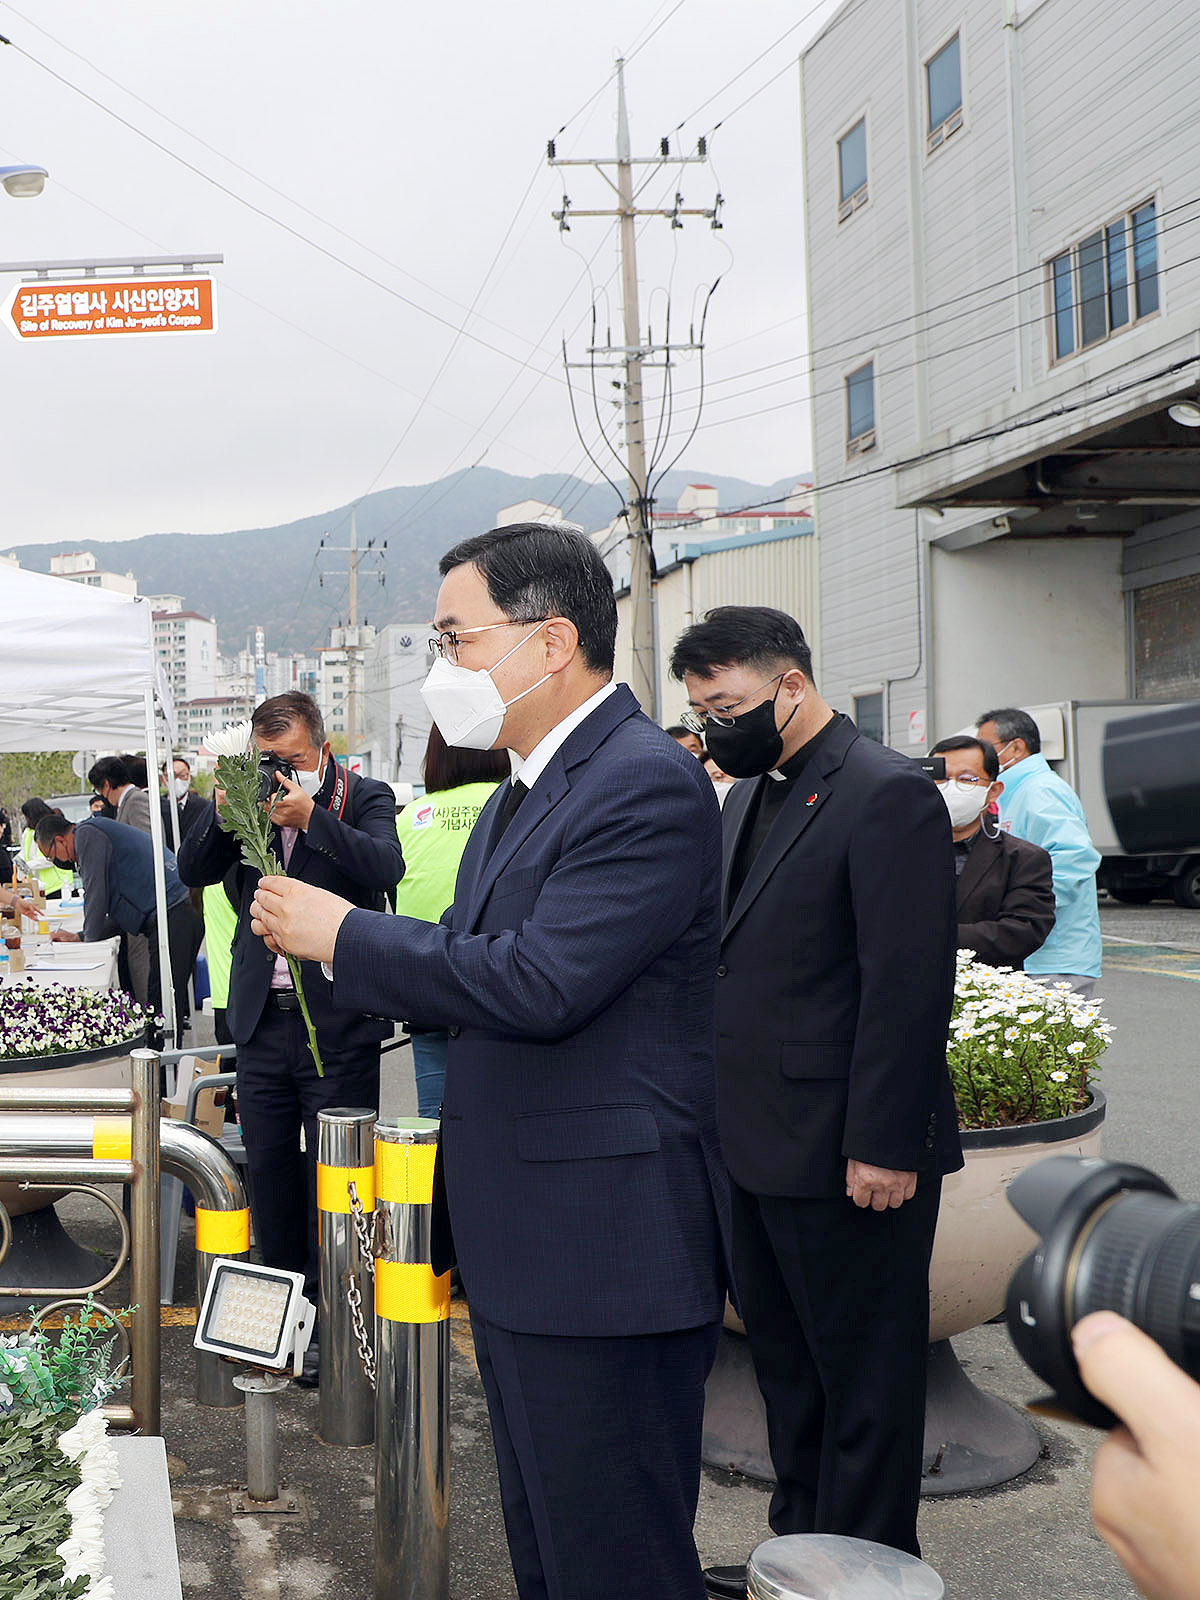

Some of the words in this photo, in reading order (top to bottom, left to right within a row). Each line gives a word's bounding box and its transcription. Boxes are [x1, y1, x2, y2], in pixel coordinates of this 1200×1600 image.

[20, 290, 108, 317] 김주열열사
[111, 286, 199, 313] 시신인양지
[20, 320, 38, 332] Site
[39, 319, 49, 331] of
[50, 318, 93, 331] Recovery
[94, 317, 104, 329] of
[105, 316, 124, 328] Kim
[168, 314, 201, 327] Corpse
[336, 778, 344, 797] EOS
